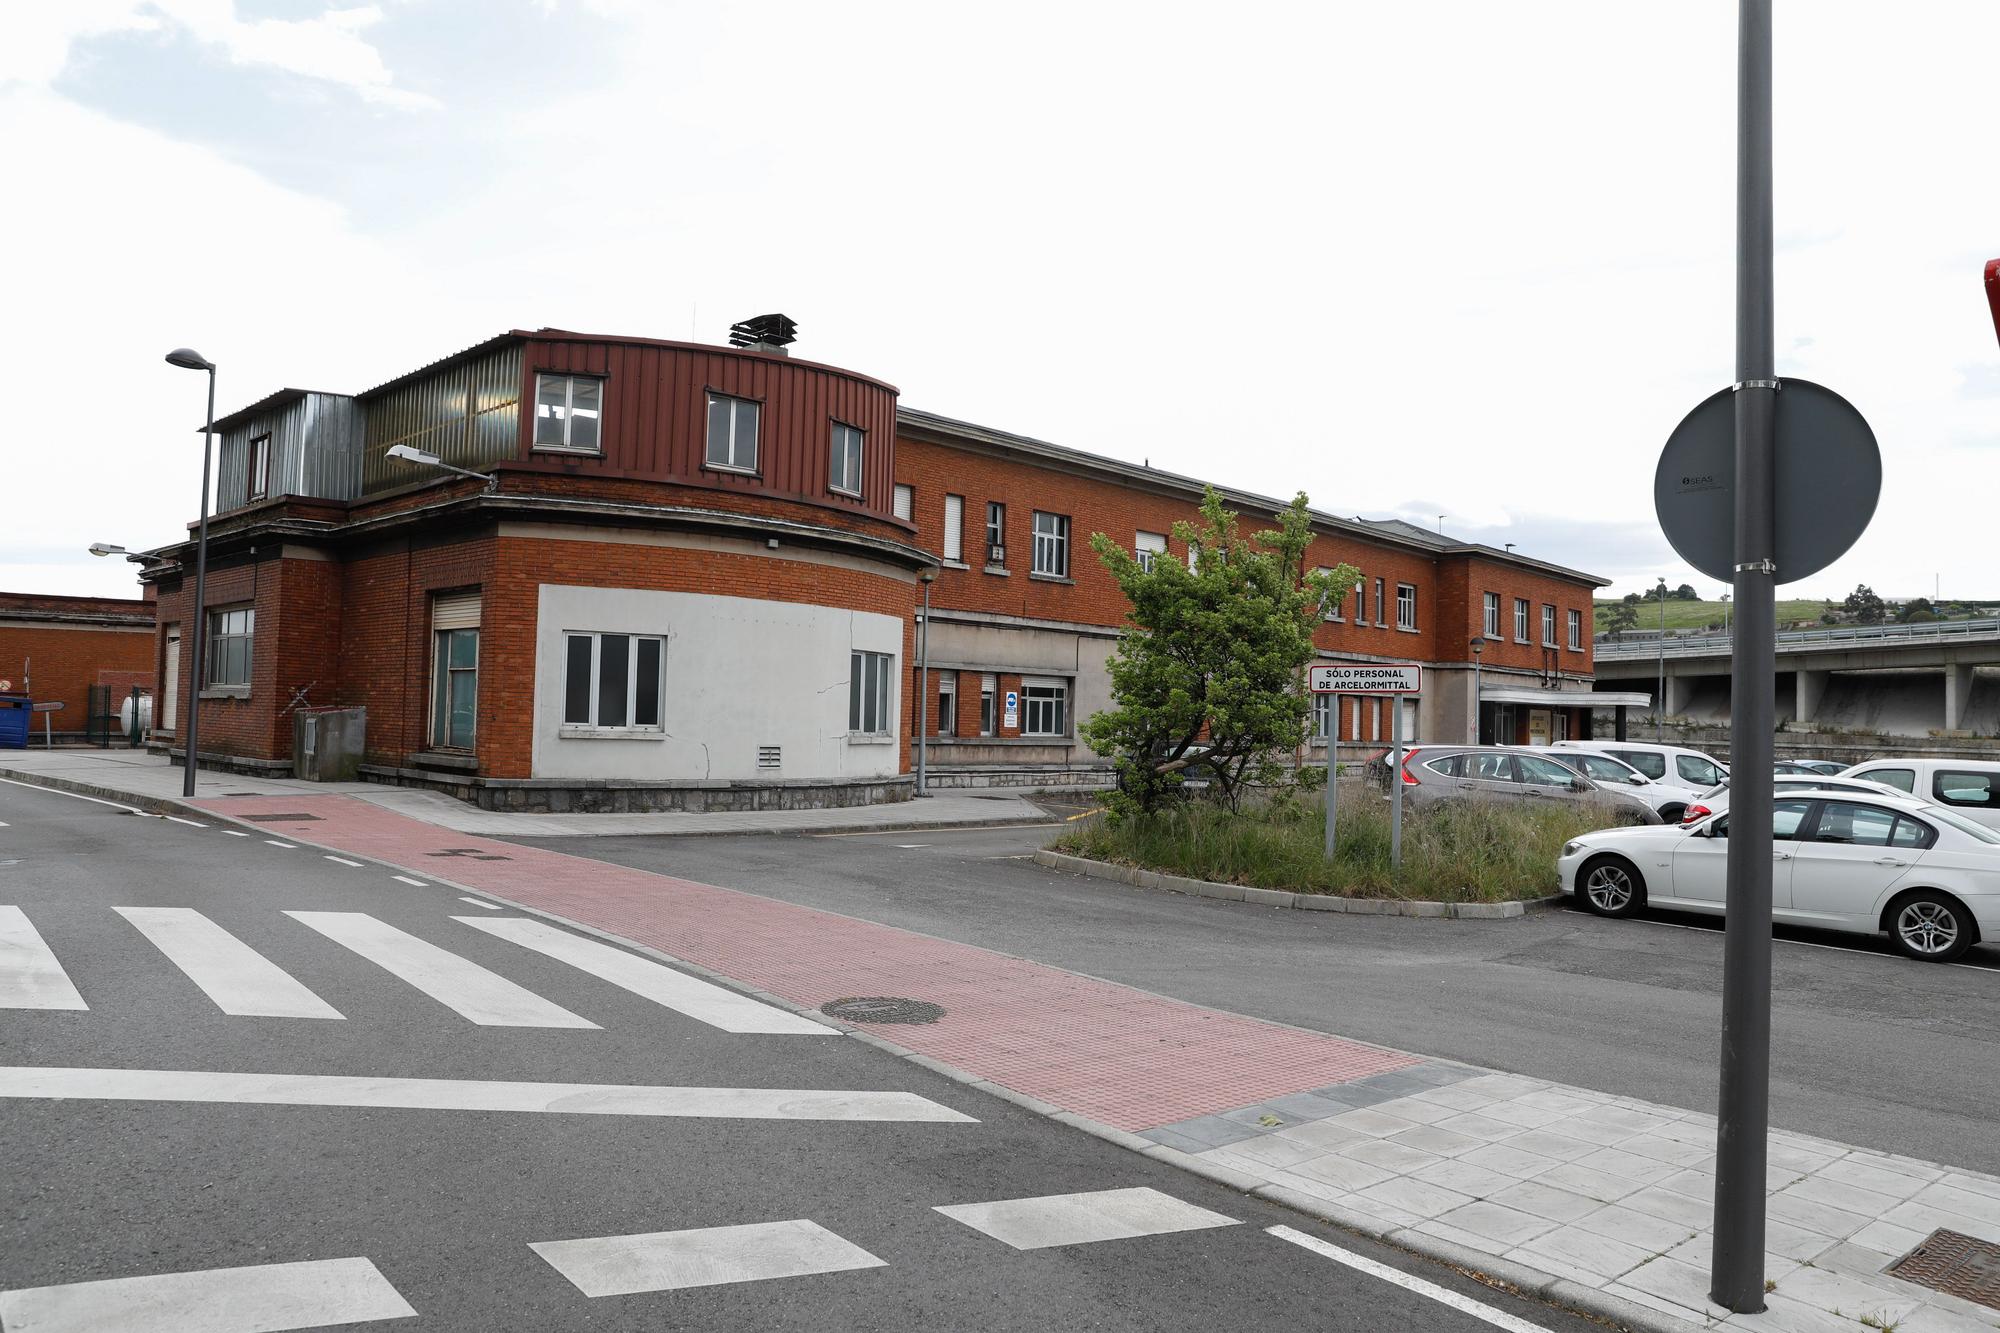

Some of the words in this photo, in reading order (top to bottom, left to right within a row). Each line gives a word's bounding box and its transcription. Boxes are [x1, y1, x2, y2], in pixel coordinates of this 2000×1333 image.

[1326, 667, 1351, 678] SÓLO
[1353, 670, 1404, 678] PERSONAL
[1319, 681, 1331, 689] DE
[1334, 681, 1411, 689] ARCELORMITTAL
